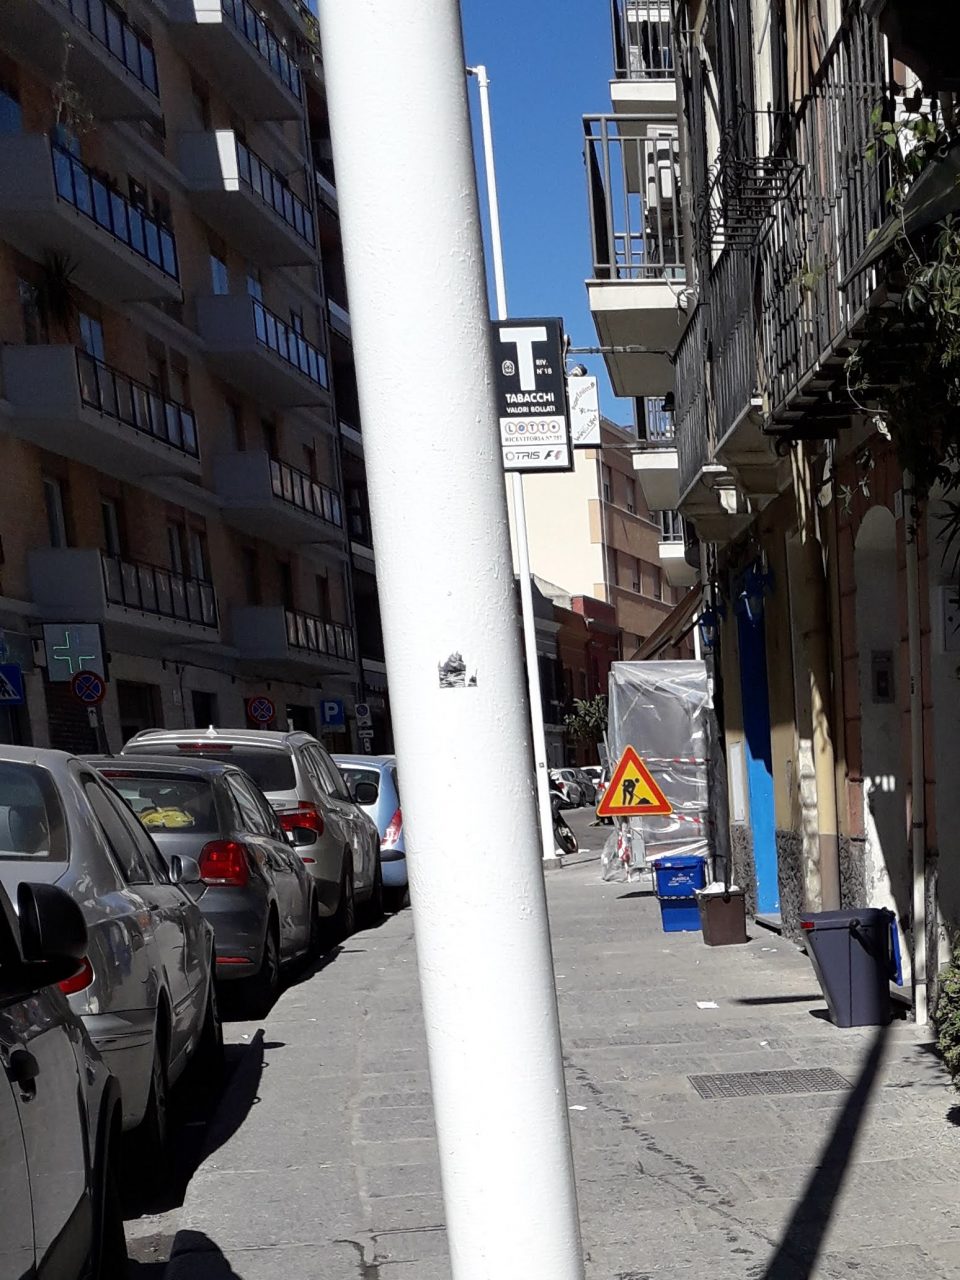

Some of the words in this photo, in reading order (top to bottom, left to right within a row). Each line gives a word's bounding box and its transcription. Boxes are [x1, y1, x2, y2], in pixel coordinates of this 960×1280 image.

[499, 327, 548, 391] T
[505, 392, 555, 403] TABACCHI
[530, 405, 555, 413] BOLLATI
[505, 421, 560, 434] LOTTO
[515, 451, 541, 460] TRIS
[324, 702, 339, 722] P
